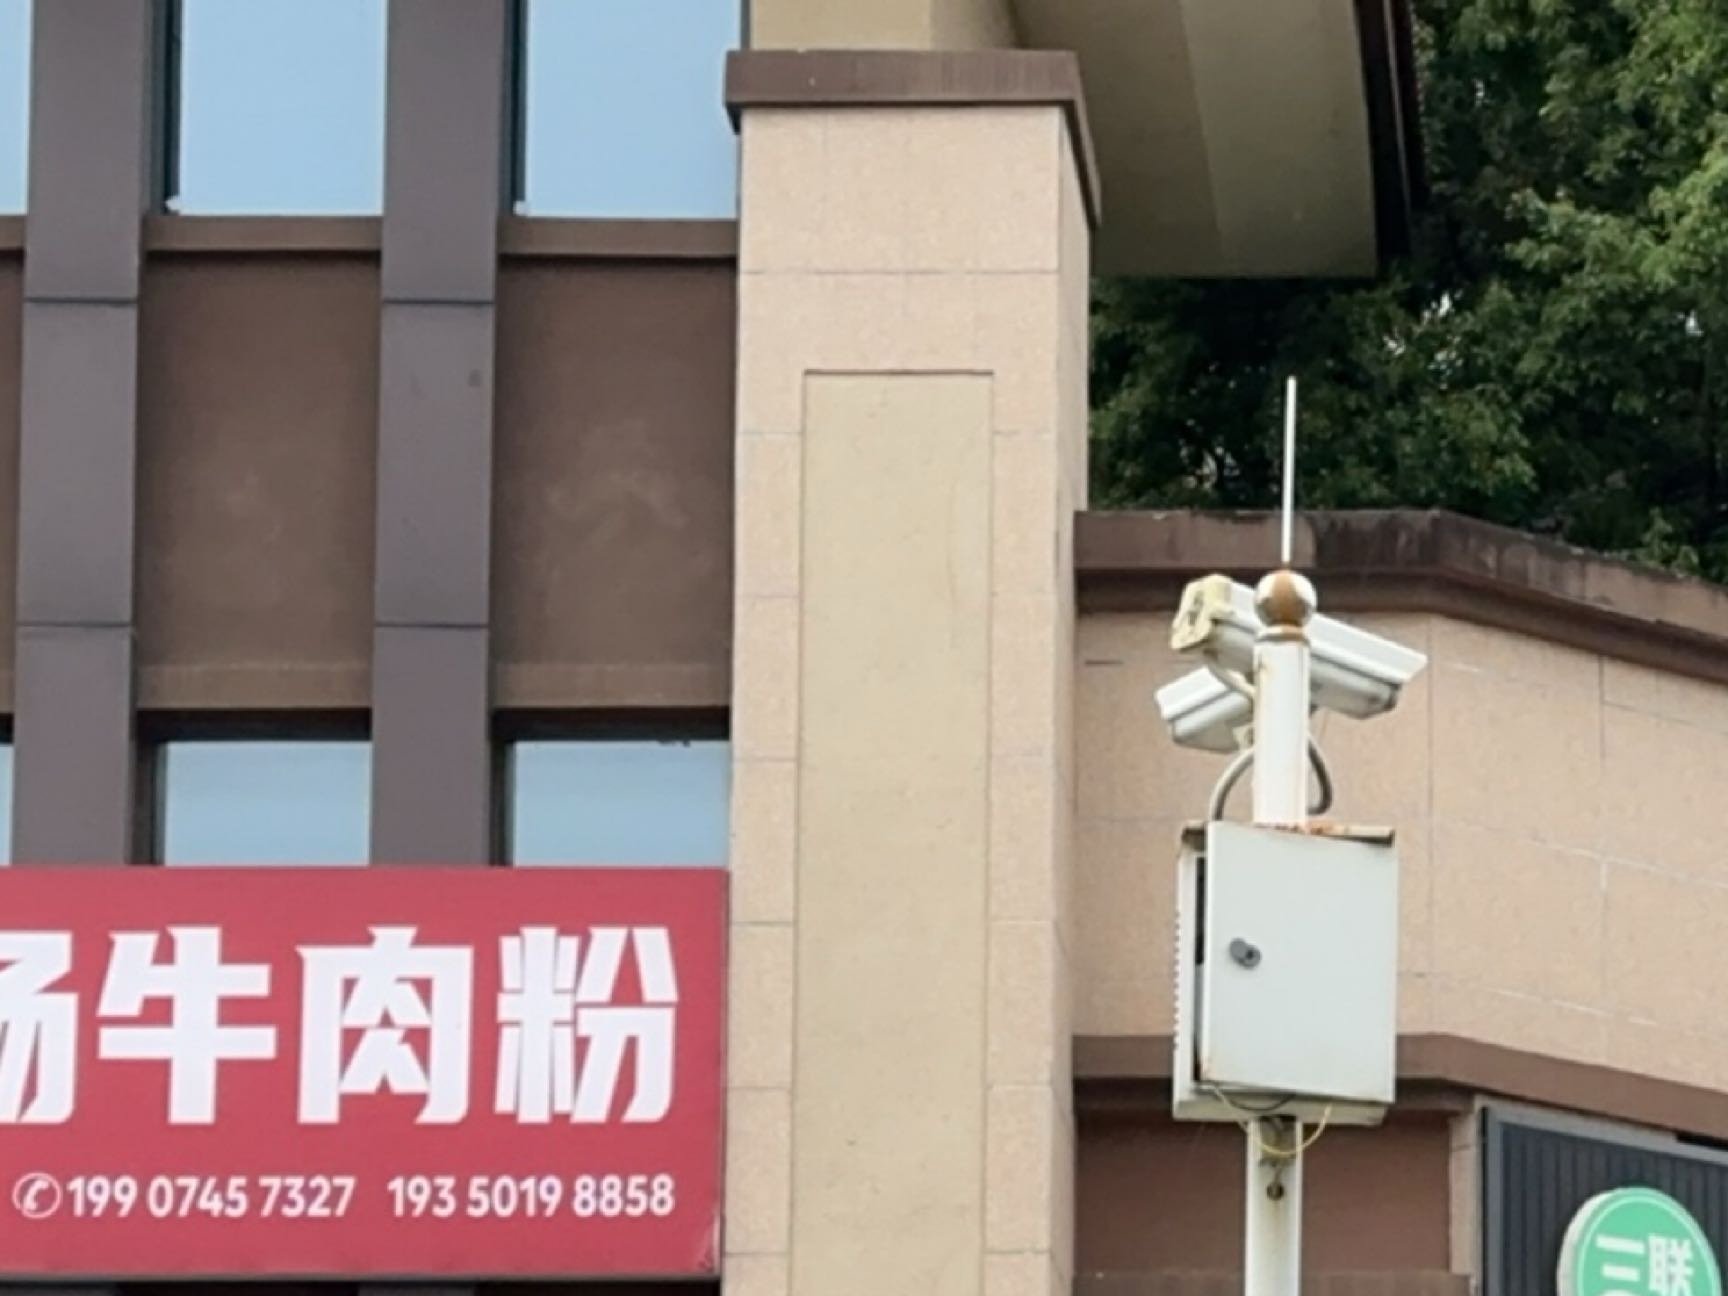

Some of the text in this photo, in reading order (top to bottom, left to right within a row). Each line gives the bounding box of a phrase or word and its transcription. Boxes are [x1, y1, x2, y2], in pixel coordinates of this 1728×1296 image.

[68, 1173, 676, 1220] 199 0745 7327 193 5019 8858
